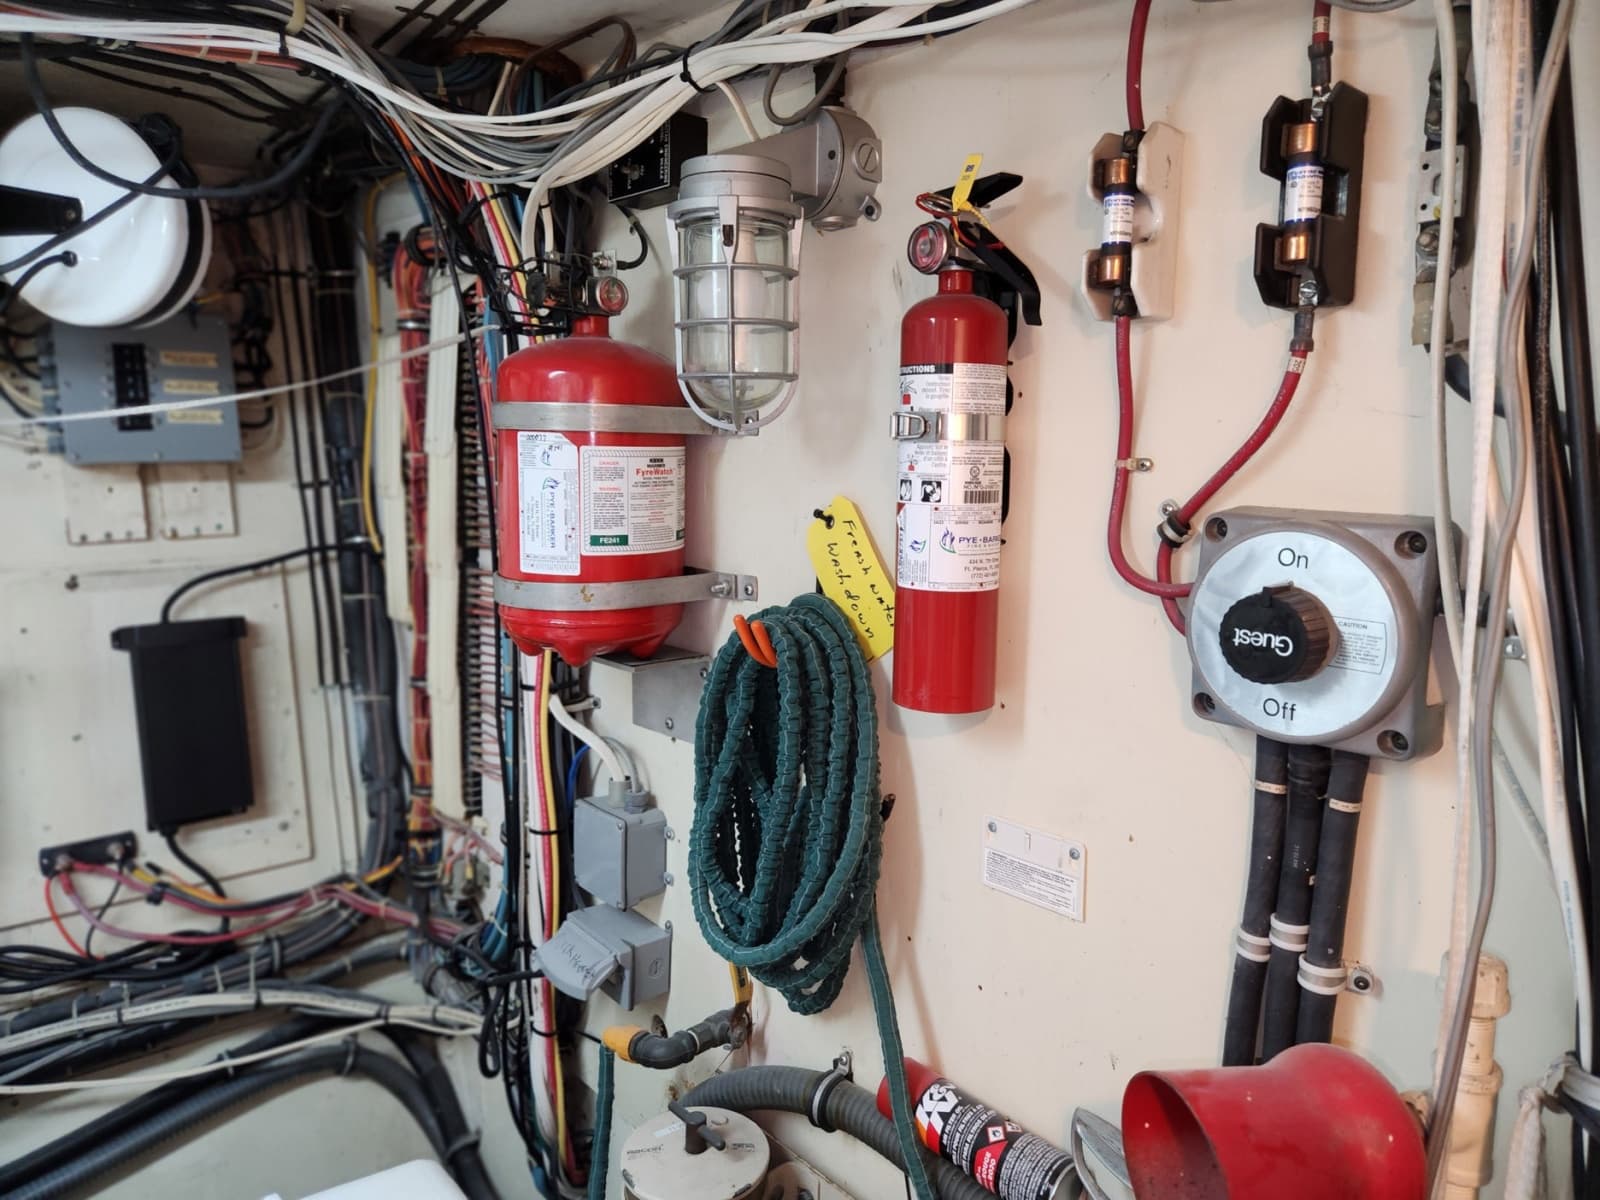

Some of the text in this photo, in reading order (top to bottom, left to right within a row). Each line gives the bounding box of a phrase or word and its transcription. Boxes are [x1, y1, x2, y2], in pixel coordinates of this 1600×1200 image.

[1278, 547, 1309, 570] On
[1232, 627, 1294, 657] Guest
[1262, 698, 1297, 721] Off
